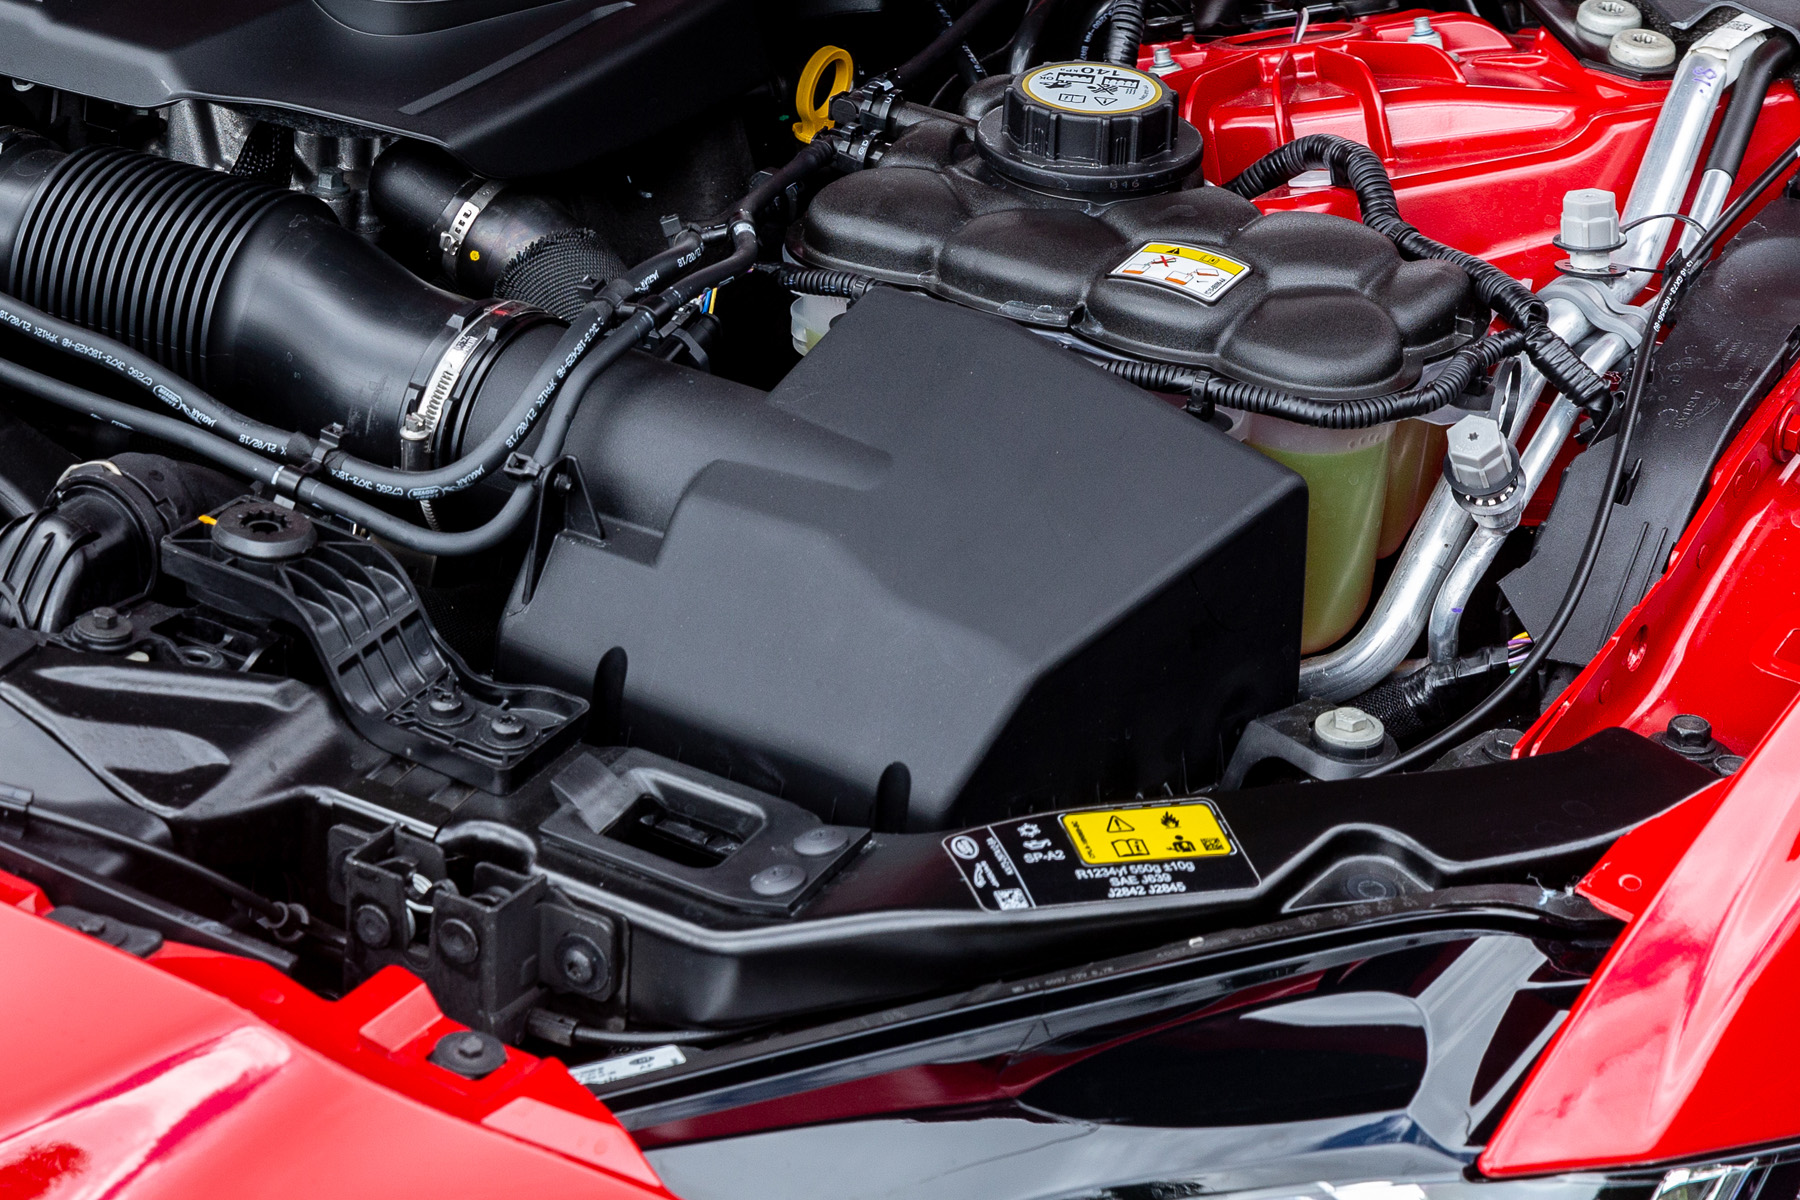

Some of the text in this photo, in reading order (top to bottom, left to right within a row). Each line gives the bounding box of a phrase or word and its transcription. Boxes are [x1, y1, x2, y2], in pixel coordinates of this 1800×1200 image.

[1080, 66, 1121, 76] 140
[190, 408, 217, 427] JAGUAR
[504, 408, 538, 448] 21/02/18
[238, 433, 277, 452] 21/02/18
[456, 464, 486, 486] JAGUAR
[1023, 850, 1066, 864] SP-A2
[1075, 866, 1128, 880] R1234yf
[1129, 864, 1161, 875] 550g
[1109, 875, 1139, 887] SAE
[1108, 882, 1186, 898] J2842 J2845
